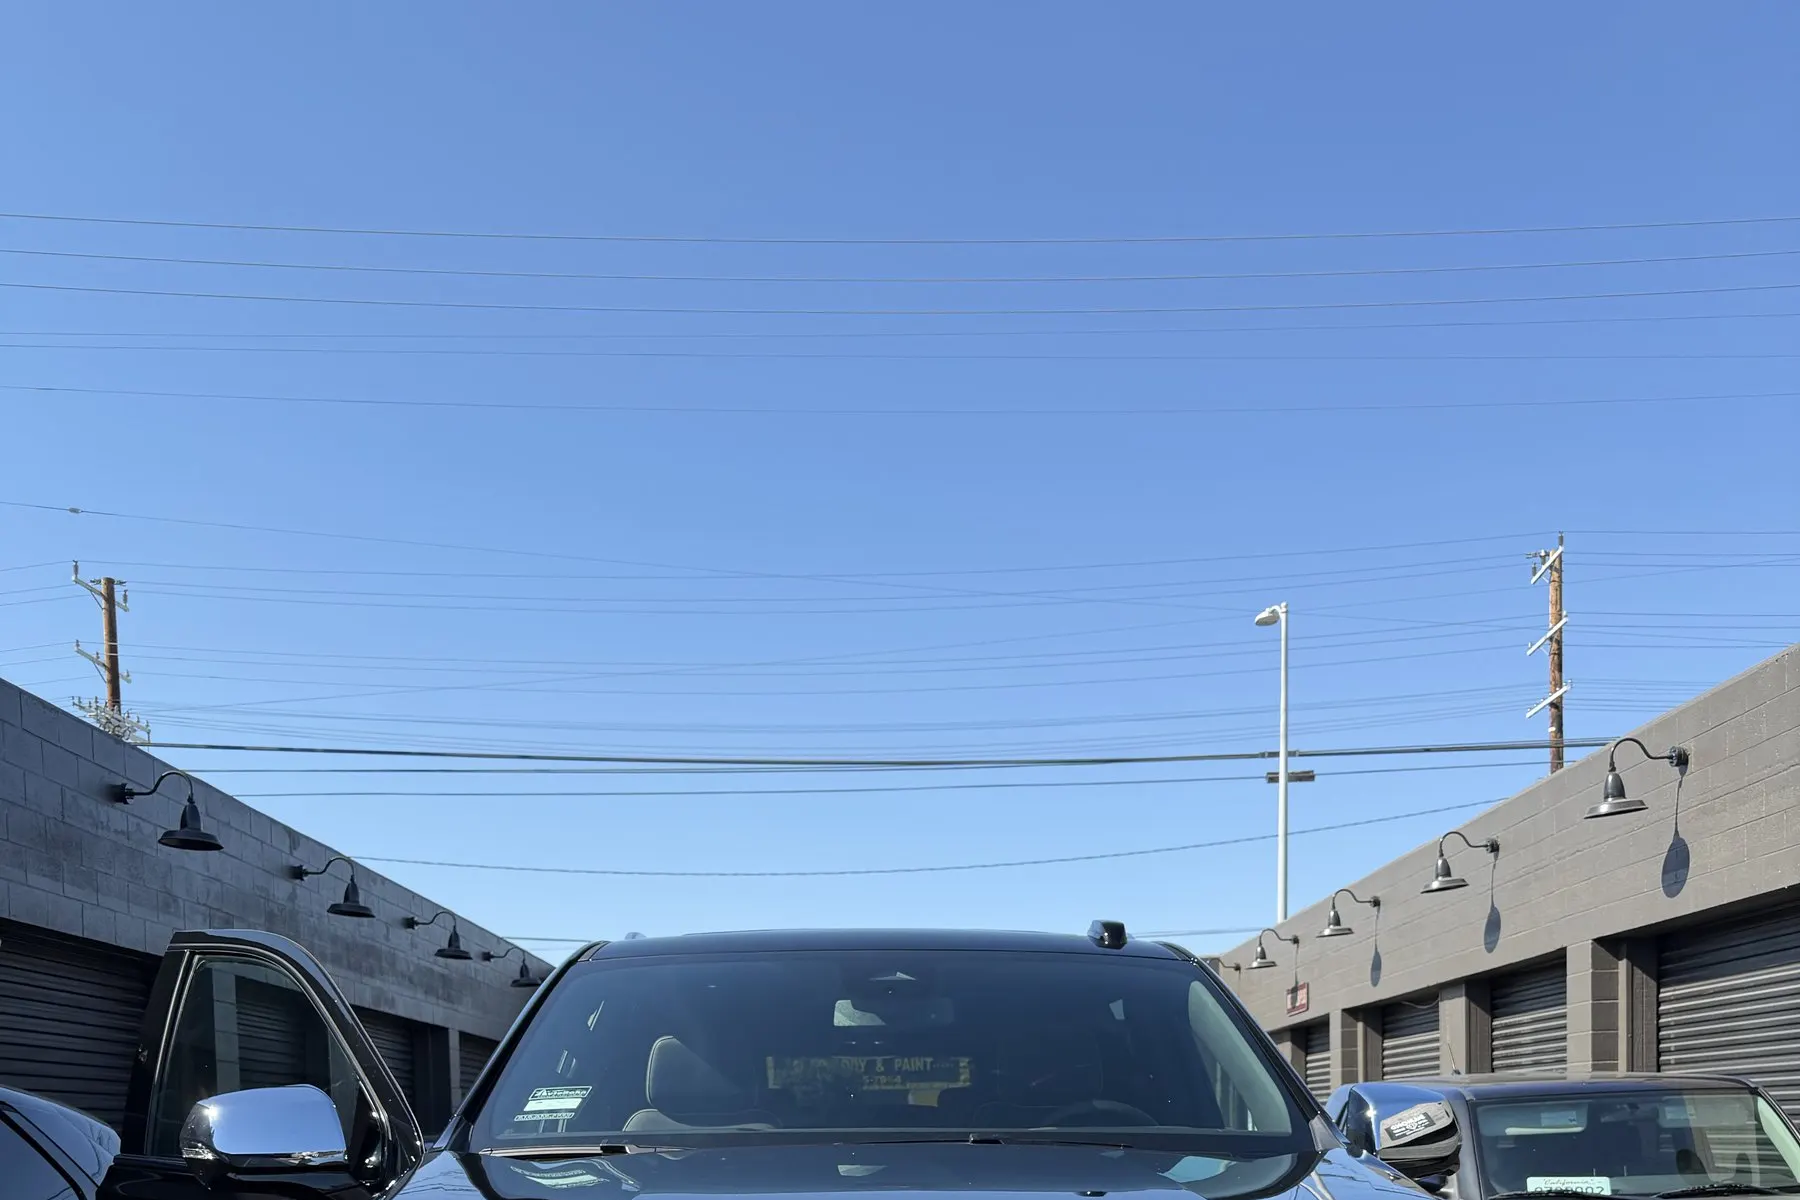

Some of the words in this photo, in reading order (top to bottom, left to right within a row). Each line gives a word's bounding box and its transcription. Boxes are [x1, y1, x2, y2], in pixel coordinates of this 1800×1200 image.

[875, 1057, 885, 1072] &
[894, 1056, 934, 1072] PAINT
[1544, 1178, 1591, 1186] California
